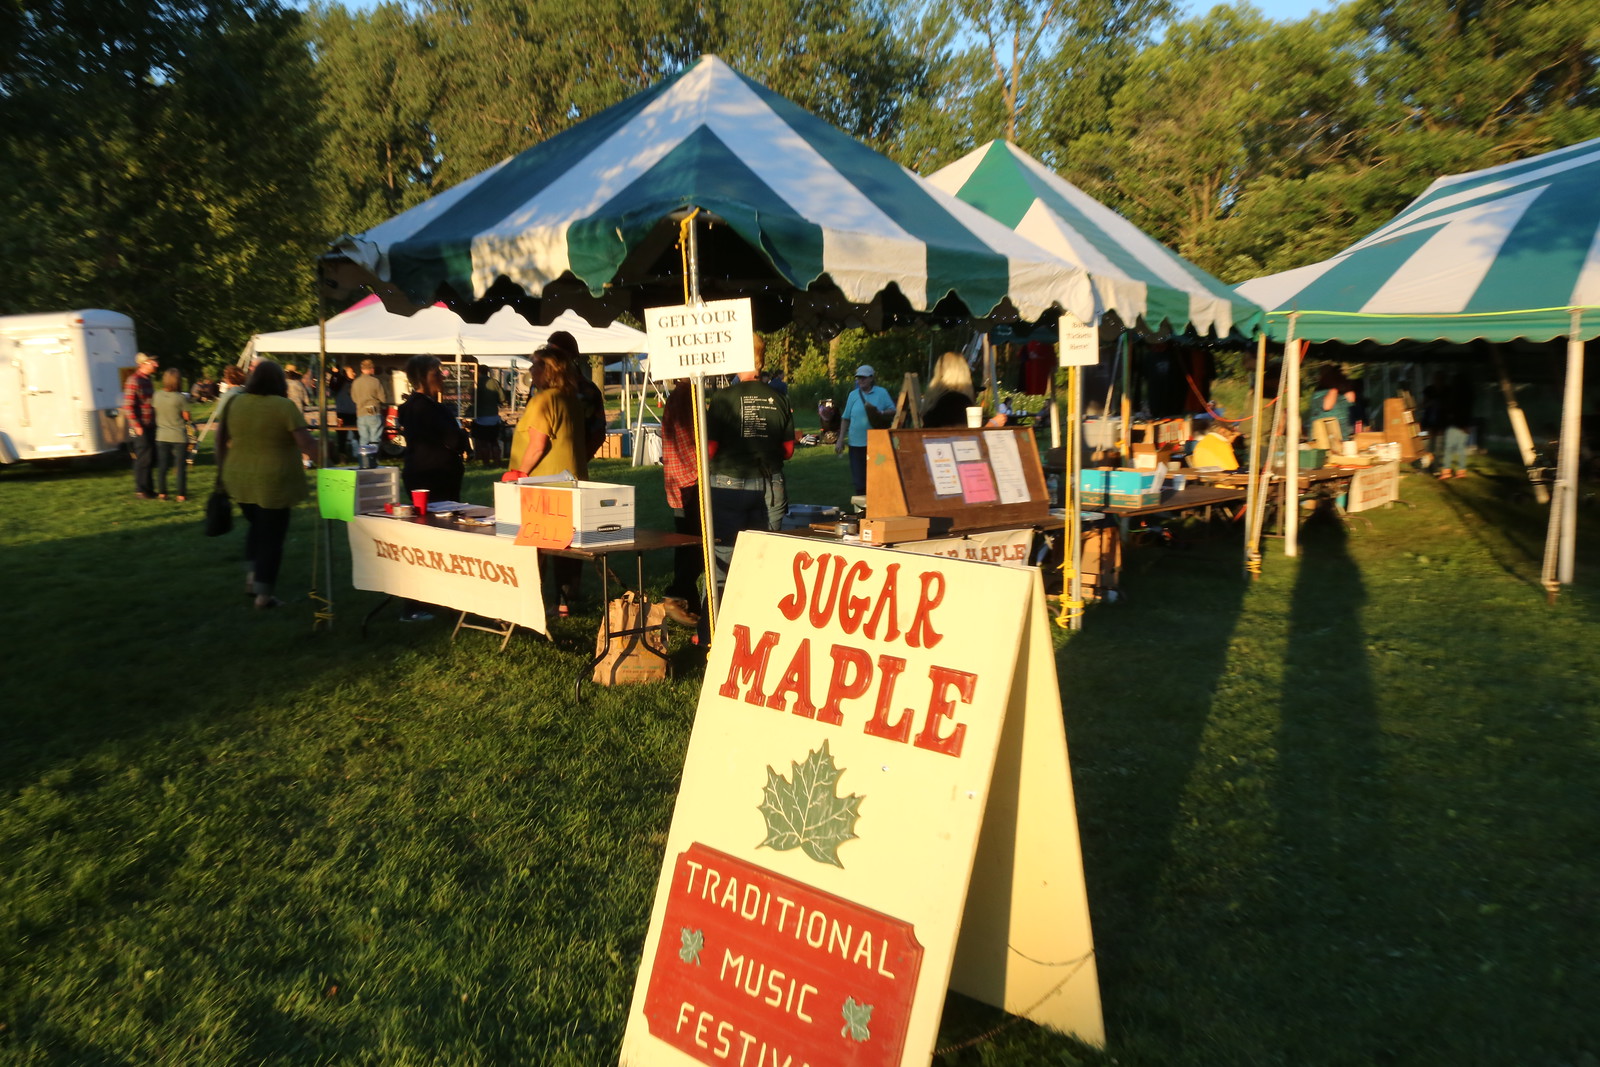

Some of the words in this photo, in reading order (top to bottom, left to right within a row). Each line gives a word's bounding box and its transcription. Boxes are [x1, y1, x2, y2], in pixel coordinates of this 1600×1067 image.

[658, 314, 688, 329] GET
[690, 310, 738, 325] YOUR
[666, 330, 733, 348] TICKETS
[678, 351, 726, 367] HERE!
[525, 493, 568, 518] WILL
[523, 522, 563, 543] CALL
[373, 538, 519, 588] INFORMATION
[965, 544, 1027, 563] MAPLE
[778, 550, 946, 650] SUGAR
[719, 624, 979, 758] MAPLE
[687, 860, 896, 980] TRADITIONAL
[719, 947, 819, 1024] MUSIC
[676, 1001, 810, 1067] FESTIV
